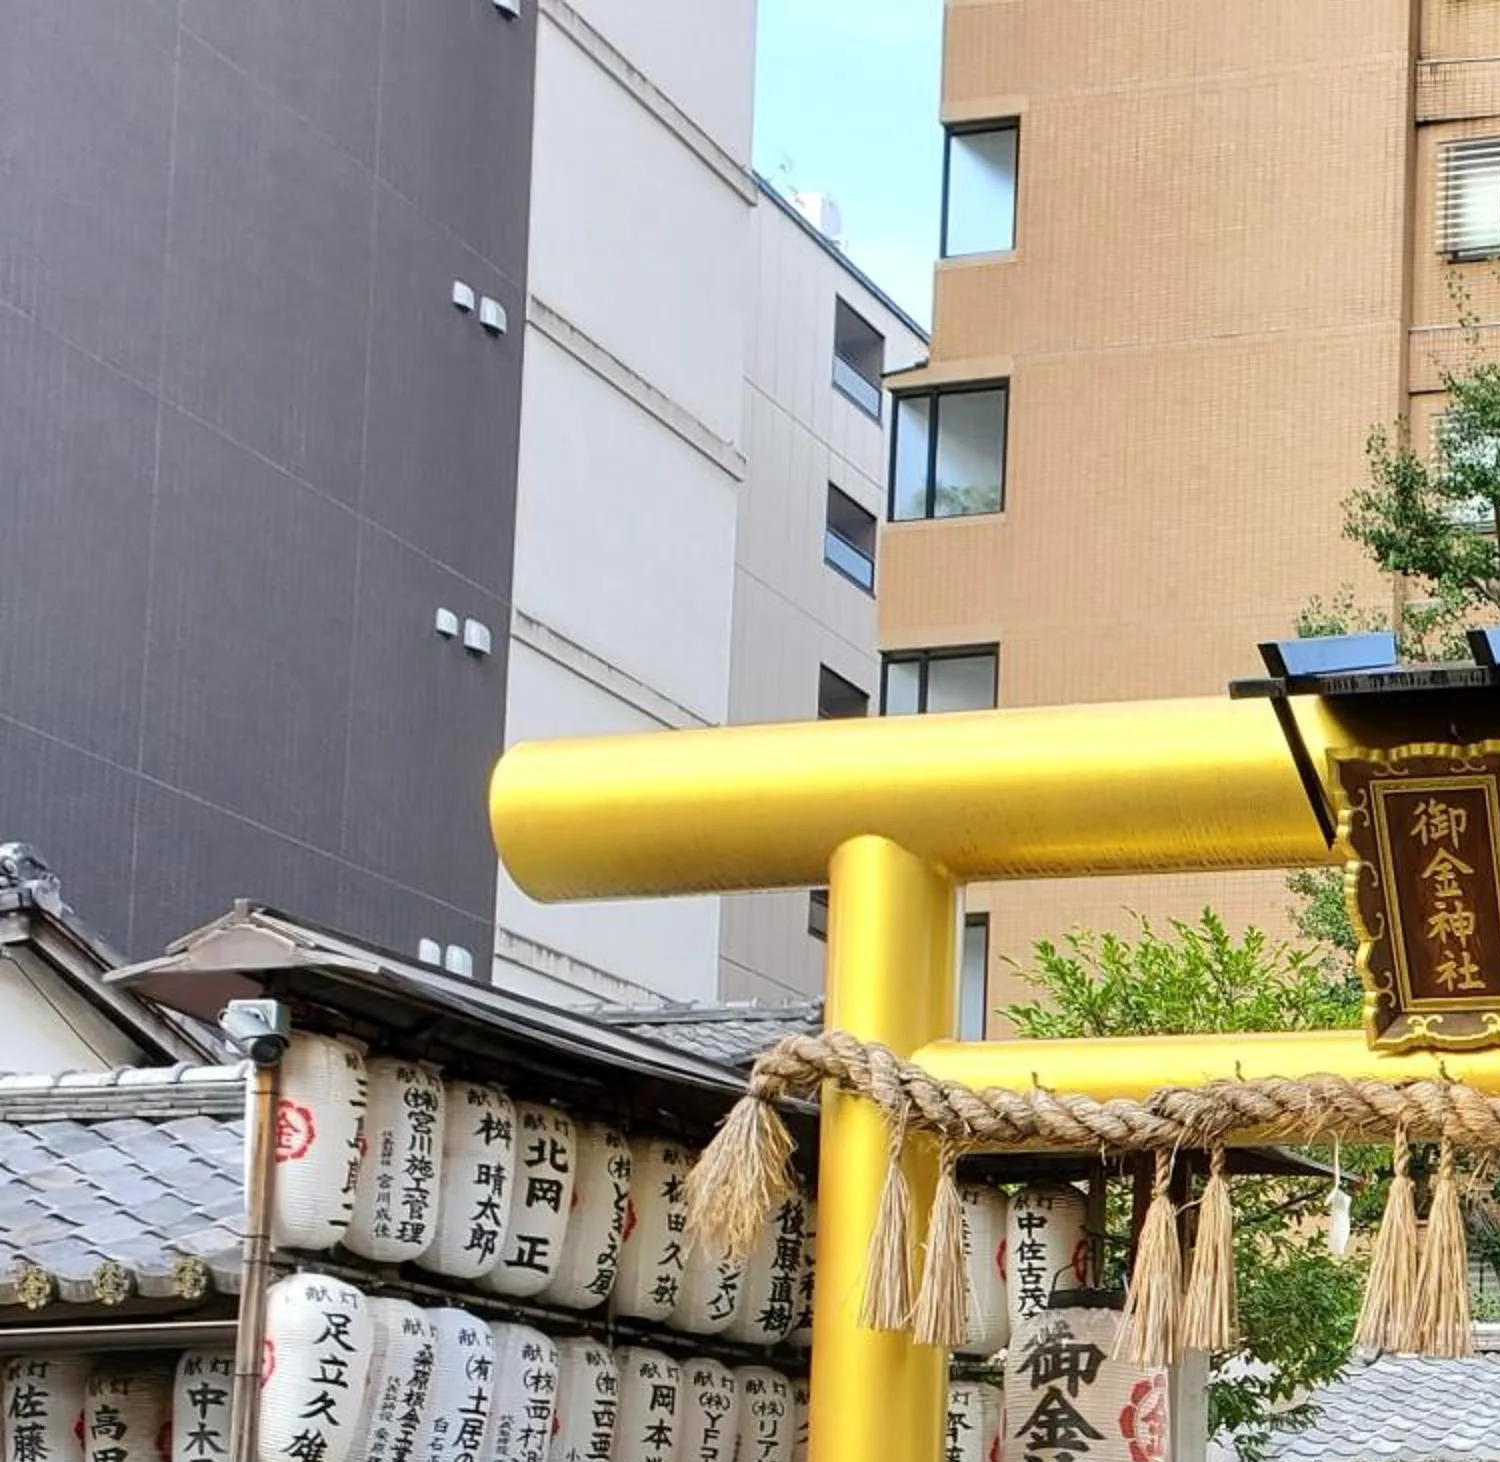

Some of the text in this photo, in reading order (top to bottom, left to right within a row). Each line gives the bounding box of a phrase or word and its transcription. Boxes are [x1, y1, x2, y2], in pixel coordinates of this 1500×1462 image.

[1411, 797, 1487, 992] 御金神社
[505, 1137, 570, 1275] 北岡正
